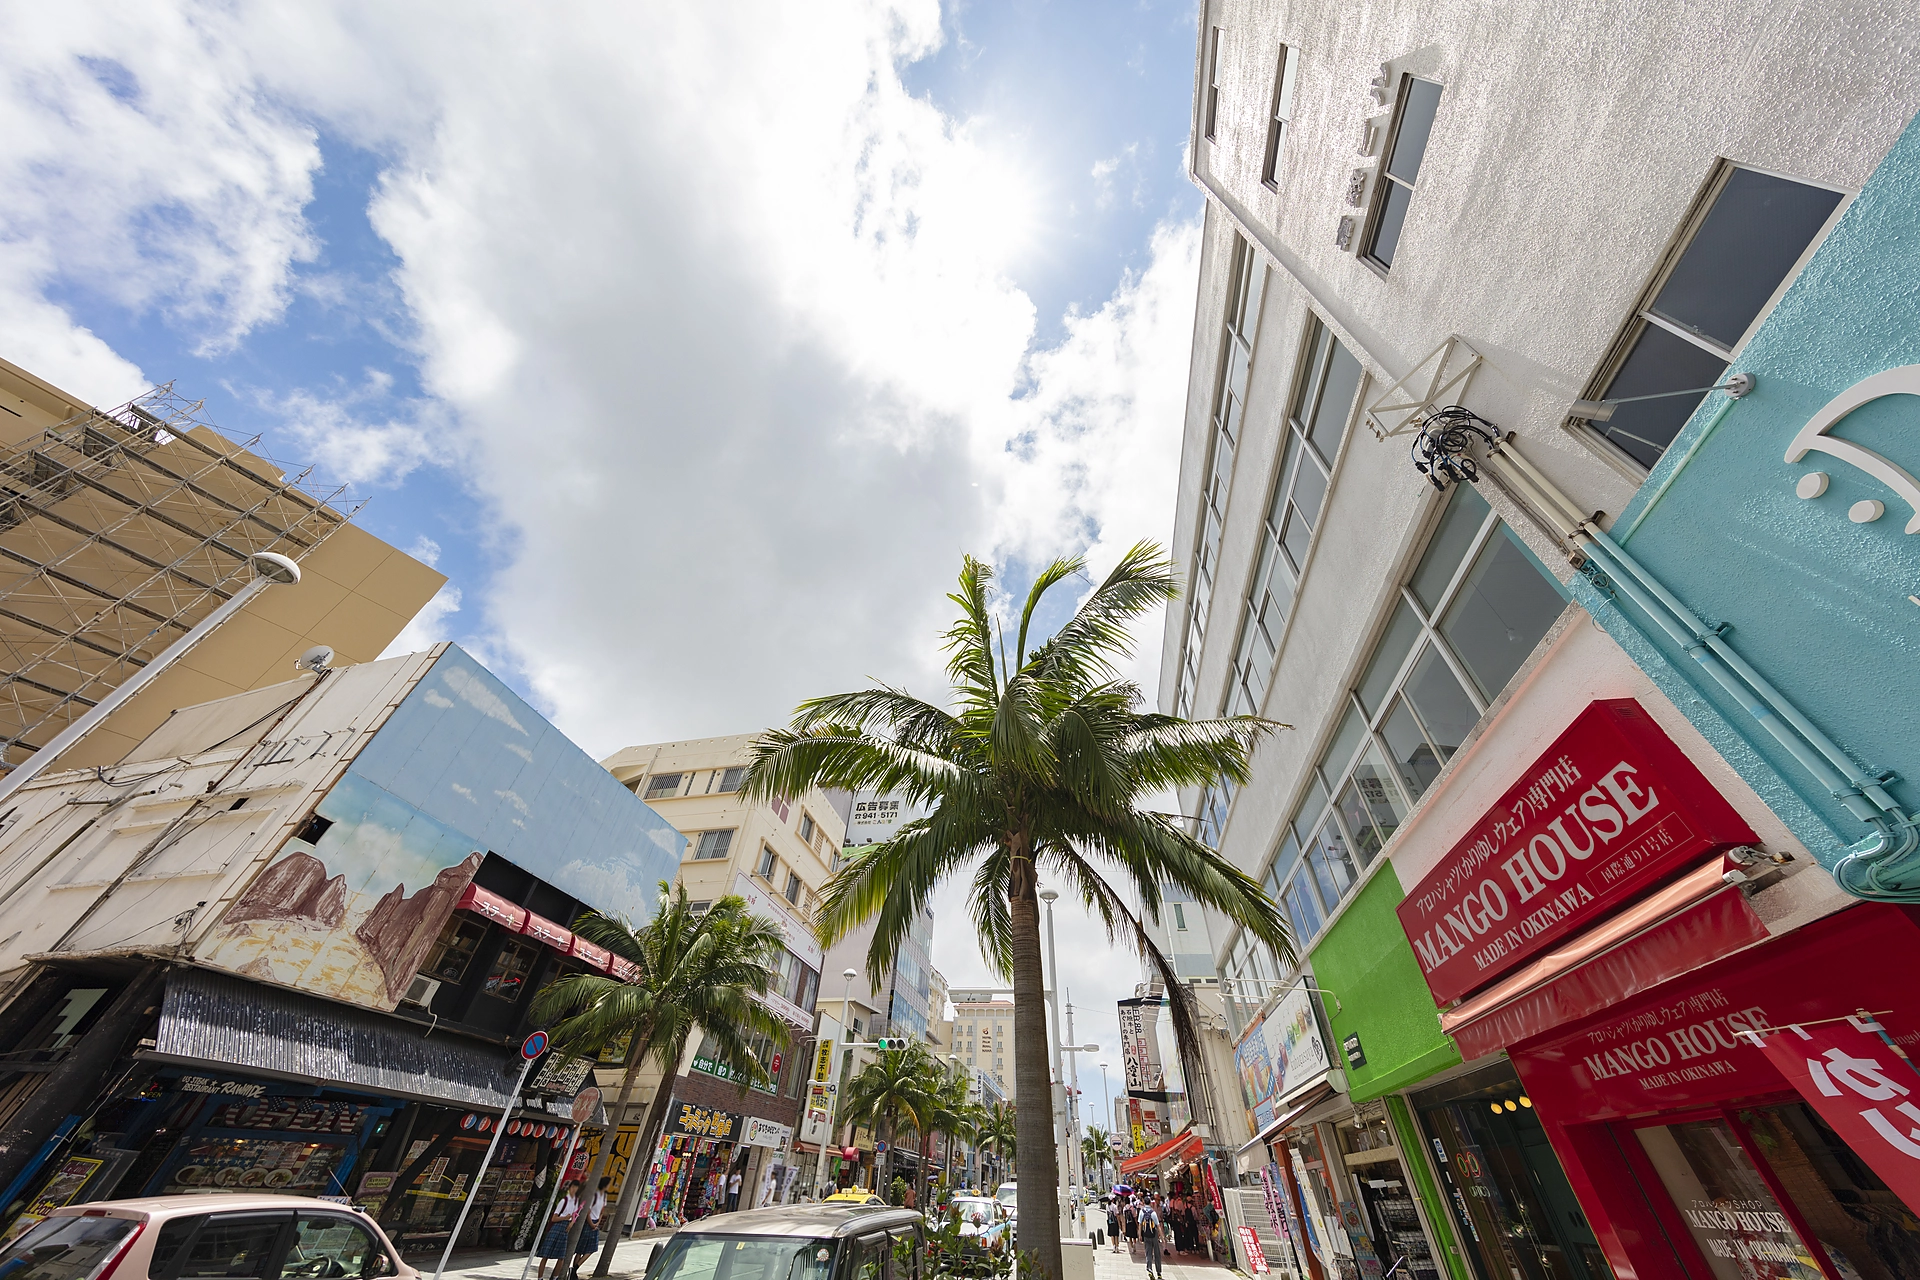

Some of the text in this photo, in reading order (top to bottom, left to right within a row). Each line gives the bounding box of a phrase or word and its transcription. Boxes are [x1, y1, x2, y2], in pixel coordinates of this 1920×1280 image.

[855, 801, 899, 811] 広告募集
[1416, 754, 1582, 917] アロハシャツ(かりゆしウェア)専門店
[1413, 760, 1660, 975] MANGO HOUSE
[1600, 829, 1674, 884] 国際通り1号店
[480, 900, 516, 927] ステーキ
[1472, 882, 1595, 971] MADE IN OKINAWA
[533, 925, 566, 947] ステーキ
[1583, 1006, 1780, 1081] MANGO HOUSE
[181, 1075, 210, 1084] US STEAK
[1127, 1057, 1142, 1087] 八重山
[1639, 1060, 1737, 1090] MADE IN OKINAWA
[182, 1083, 220, 1094] RESTAURANT
[220, 1081, 266, 1098] RAWHIDE
[1685, 1210, 1792, 1233] MANGO HOUSE
